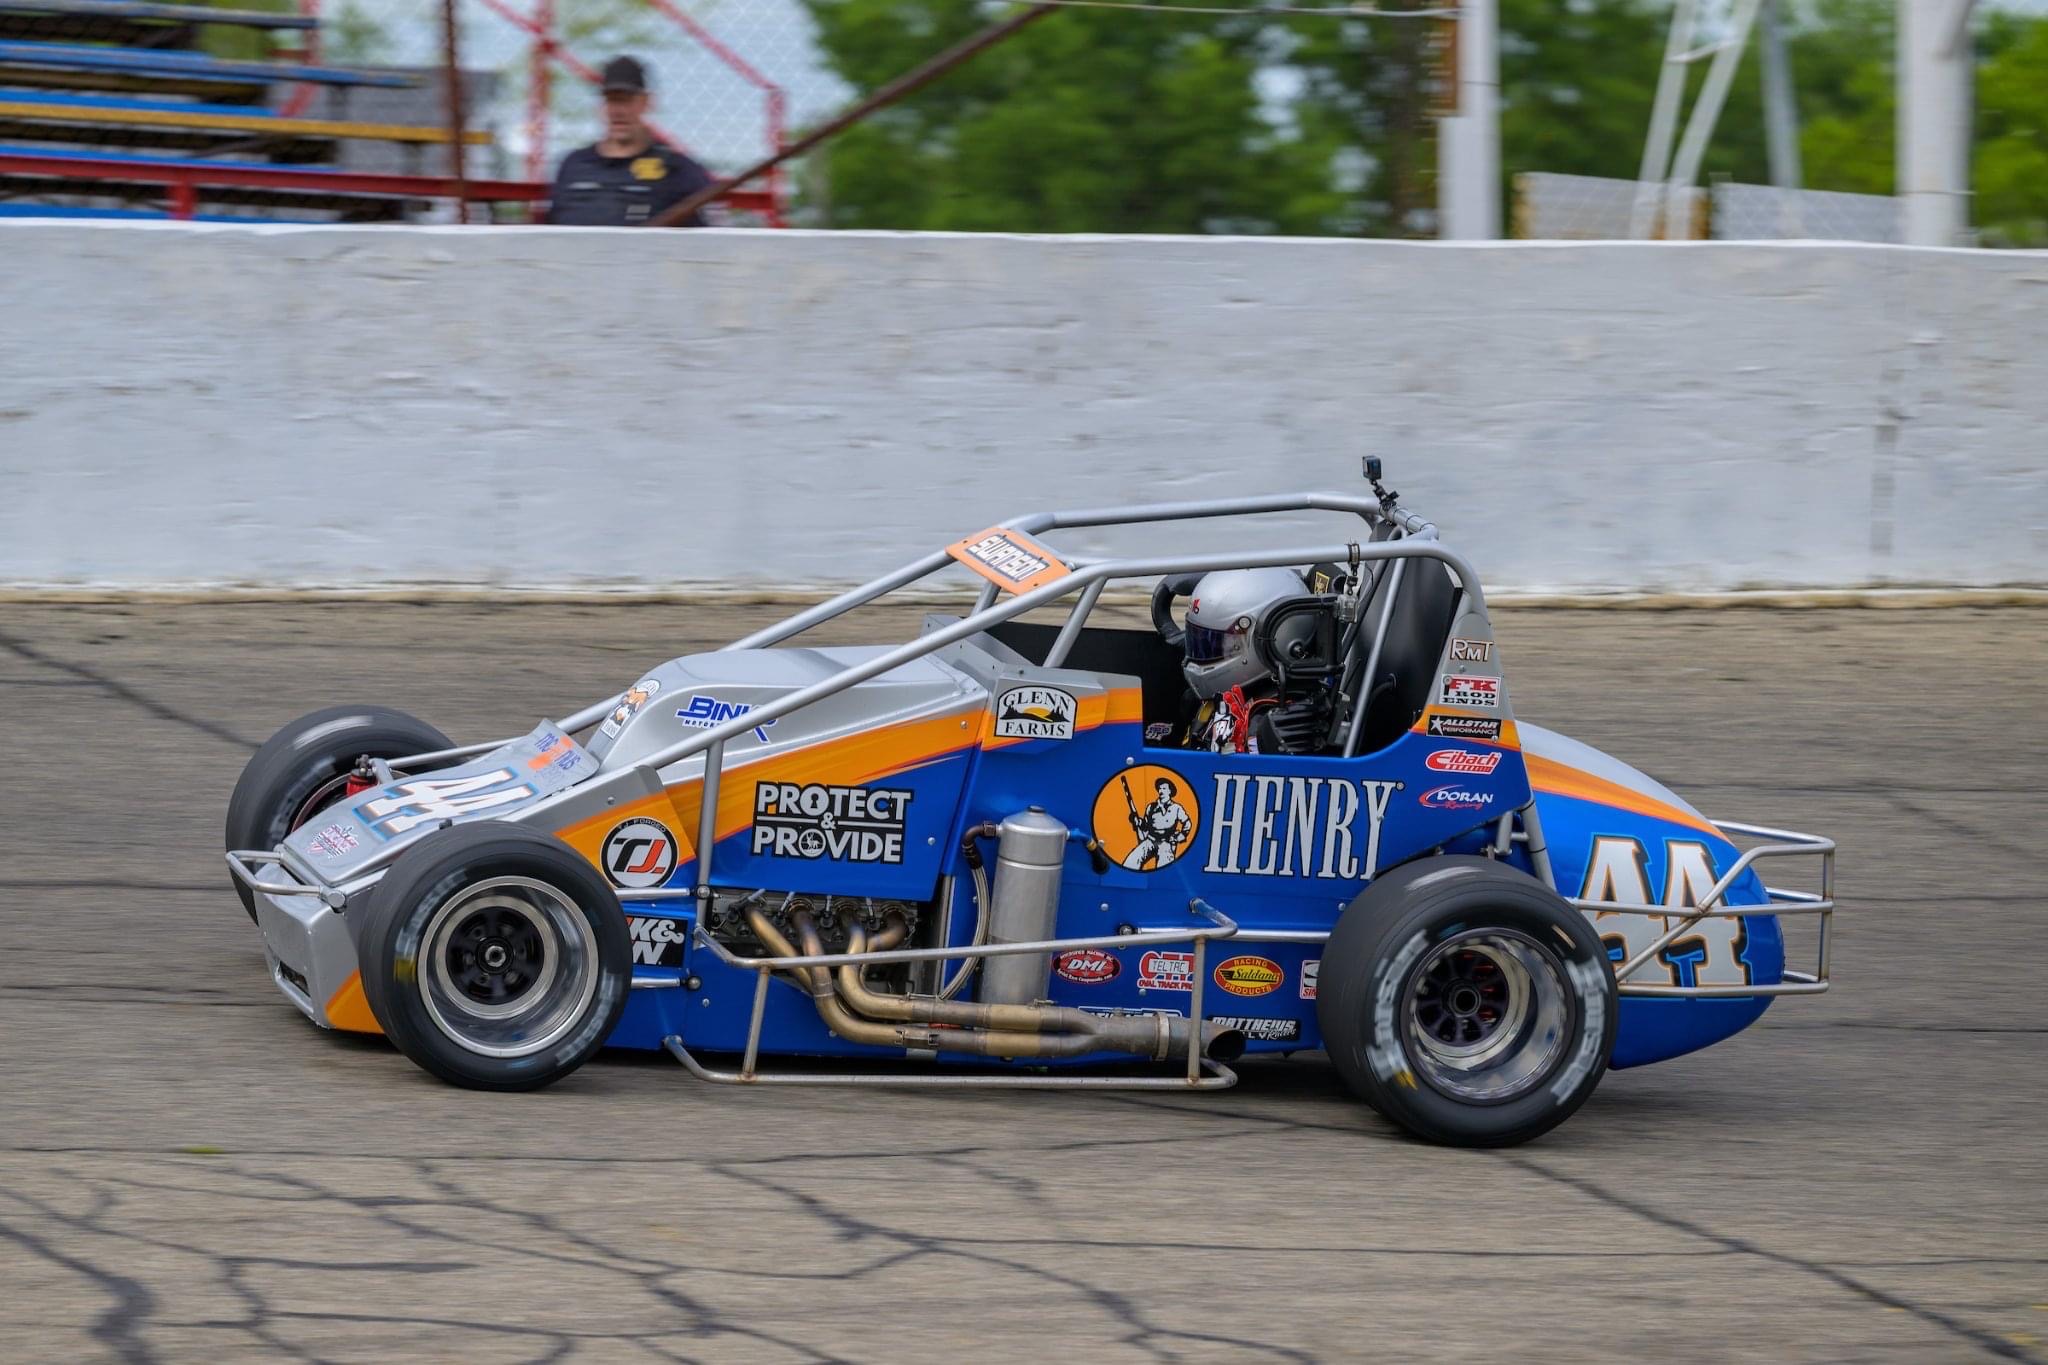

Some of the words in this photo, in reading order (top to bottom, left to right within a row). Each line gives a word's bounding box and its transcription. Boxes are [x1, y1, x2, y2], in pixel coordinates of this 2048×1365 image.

[1450, 679, 1497, 691] FK
[1003, 691, 1070, 711] GLENN
[1455, 691, 1496, 699] ROD
[1442, 697, 1495, 706] ENDS
[1005, 721, 1065, 736] FARMS
[1442, 719, 1498, 728] ALLSTAR
[1443, 727, 1497, 735] PERFORMANCE
[1428, 751, 1499, 770] Eibach
[757, 783, 912, 821] PROTECT
[1437, 791, 1493, 803] DORAN
[821, 812, 836, 829] &
[1203, 773, 1398, 880] HENRY
[753, 826, 903, 862] PROVIDE
[1580, 837, 1748, 990] 44
[1067, 959, 1106, 971] DMI
[1234, 959, 1268, 967] RACING
[1158, 981, 1179, 989] TRACK
[1225, 983, 1272, 994] PRODUCTS
